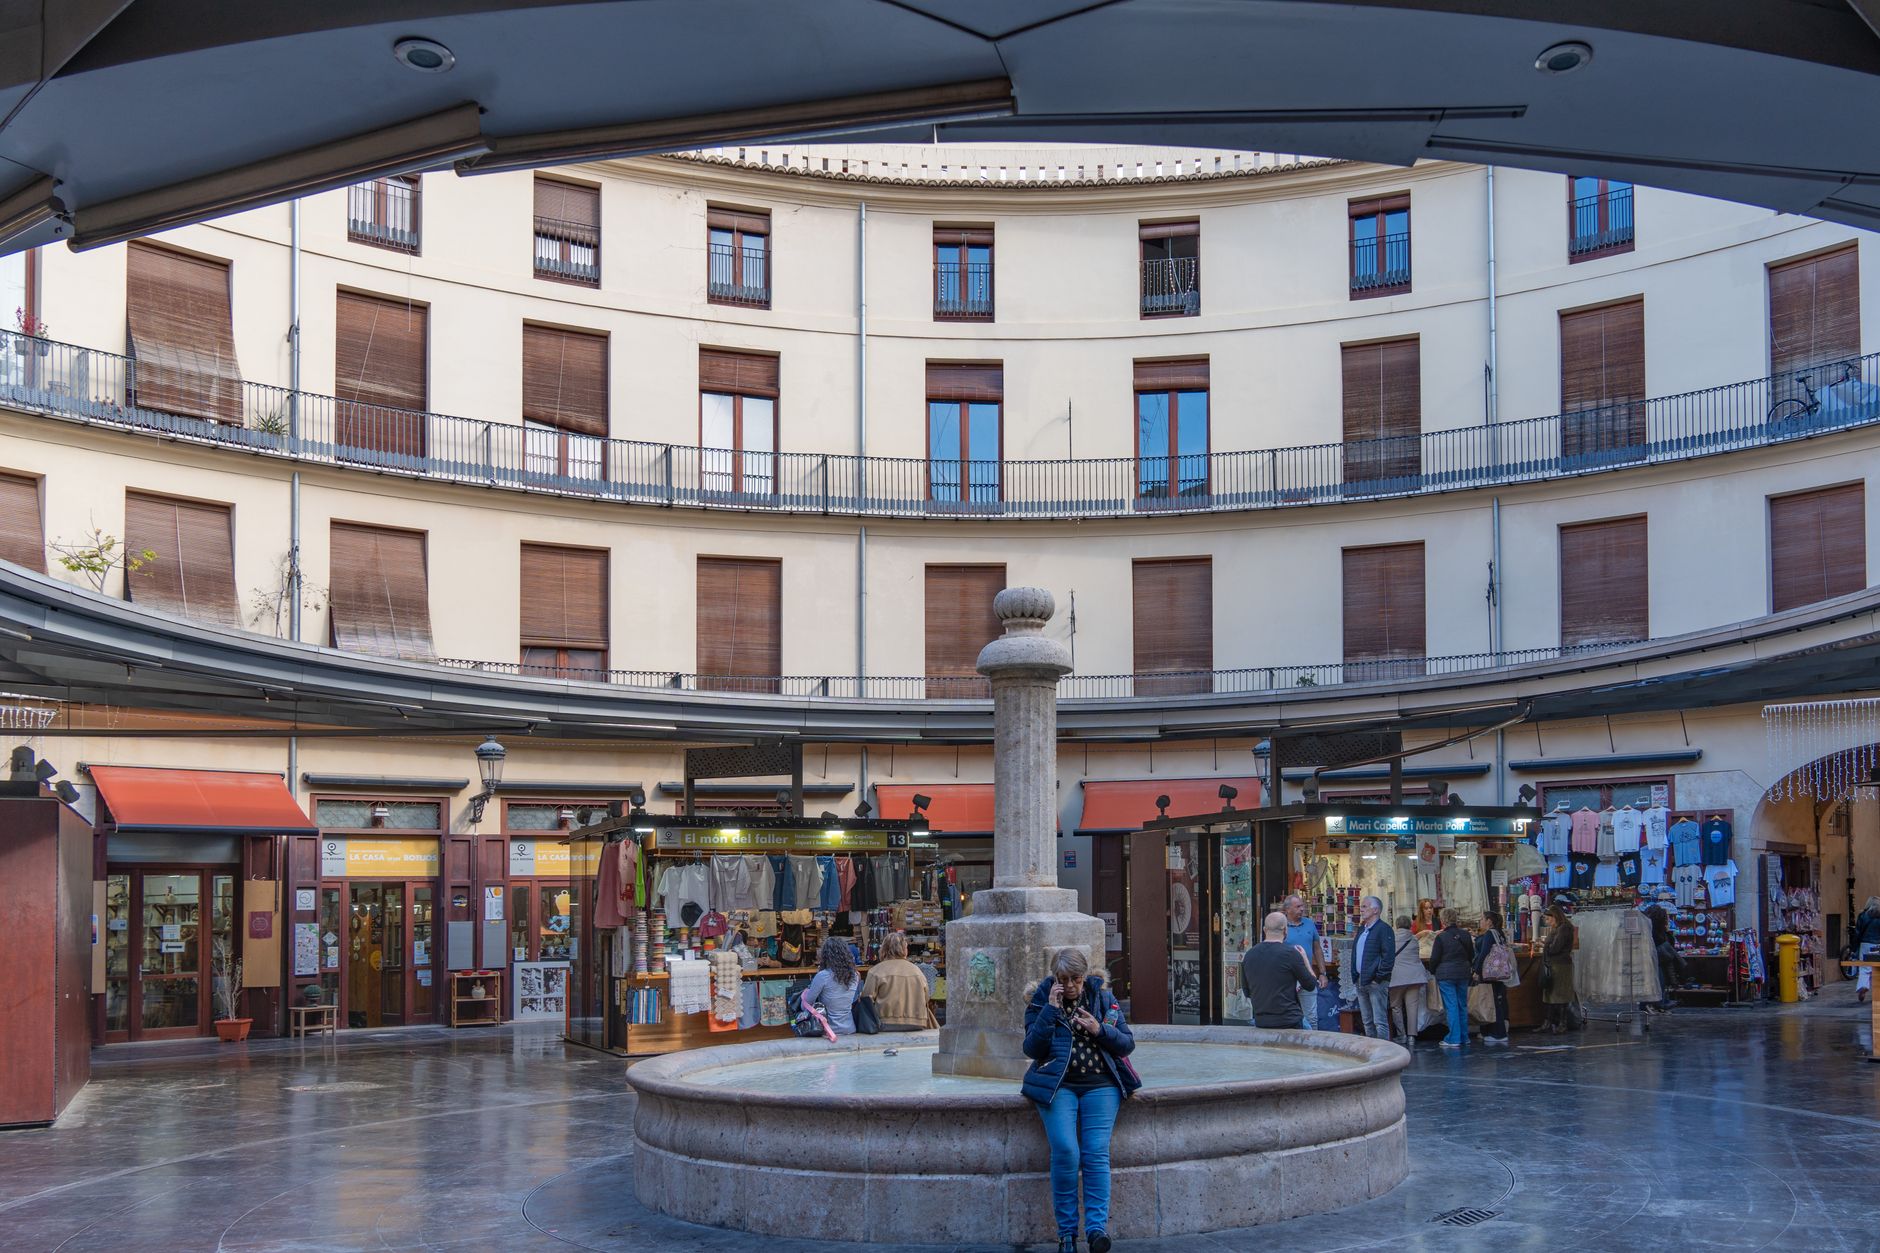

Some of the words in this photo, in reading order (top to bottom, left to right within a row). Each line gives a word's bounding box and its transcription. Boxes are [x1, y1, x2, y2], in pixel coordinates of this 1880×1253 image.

[1349, 820, 1371, 831] Mari
[1373, 820, 1408, 832] Capella
[1416, 821, 1443, 831] Marta
[1512, 821, 1524, 832] 15
[684, 833, 696, 844] El
[700, 832, 728, 844] món
[731, 833, 752, 844] del
[755, 834, 789, 845] faller
[891, 834, 906, 845] 13
